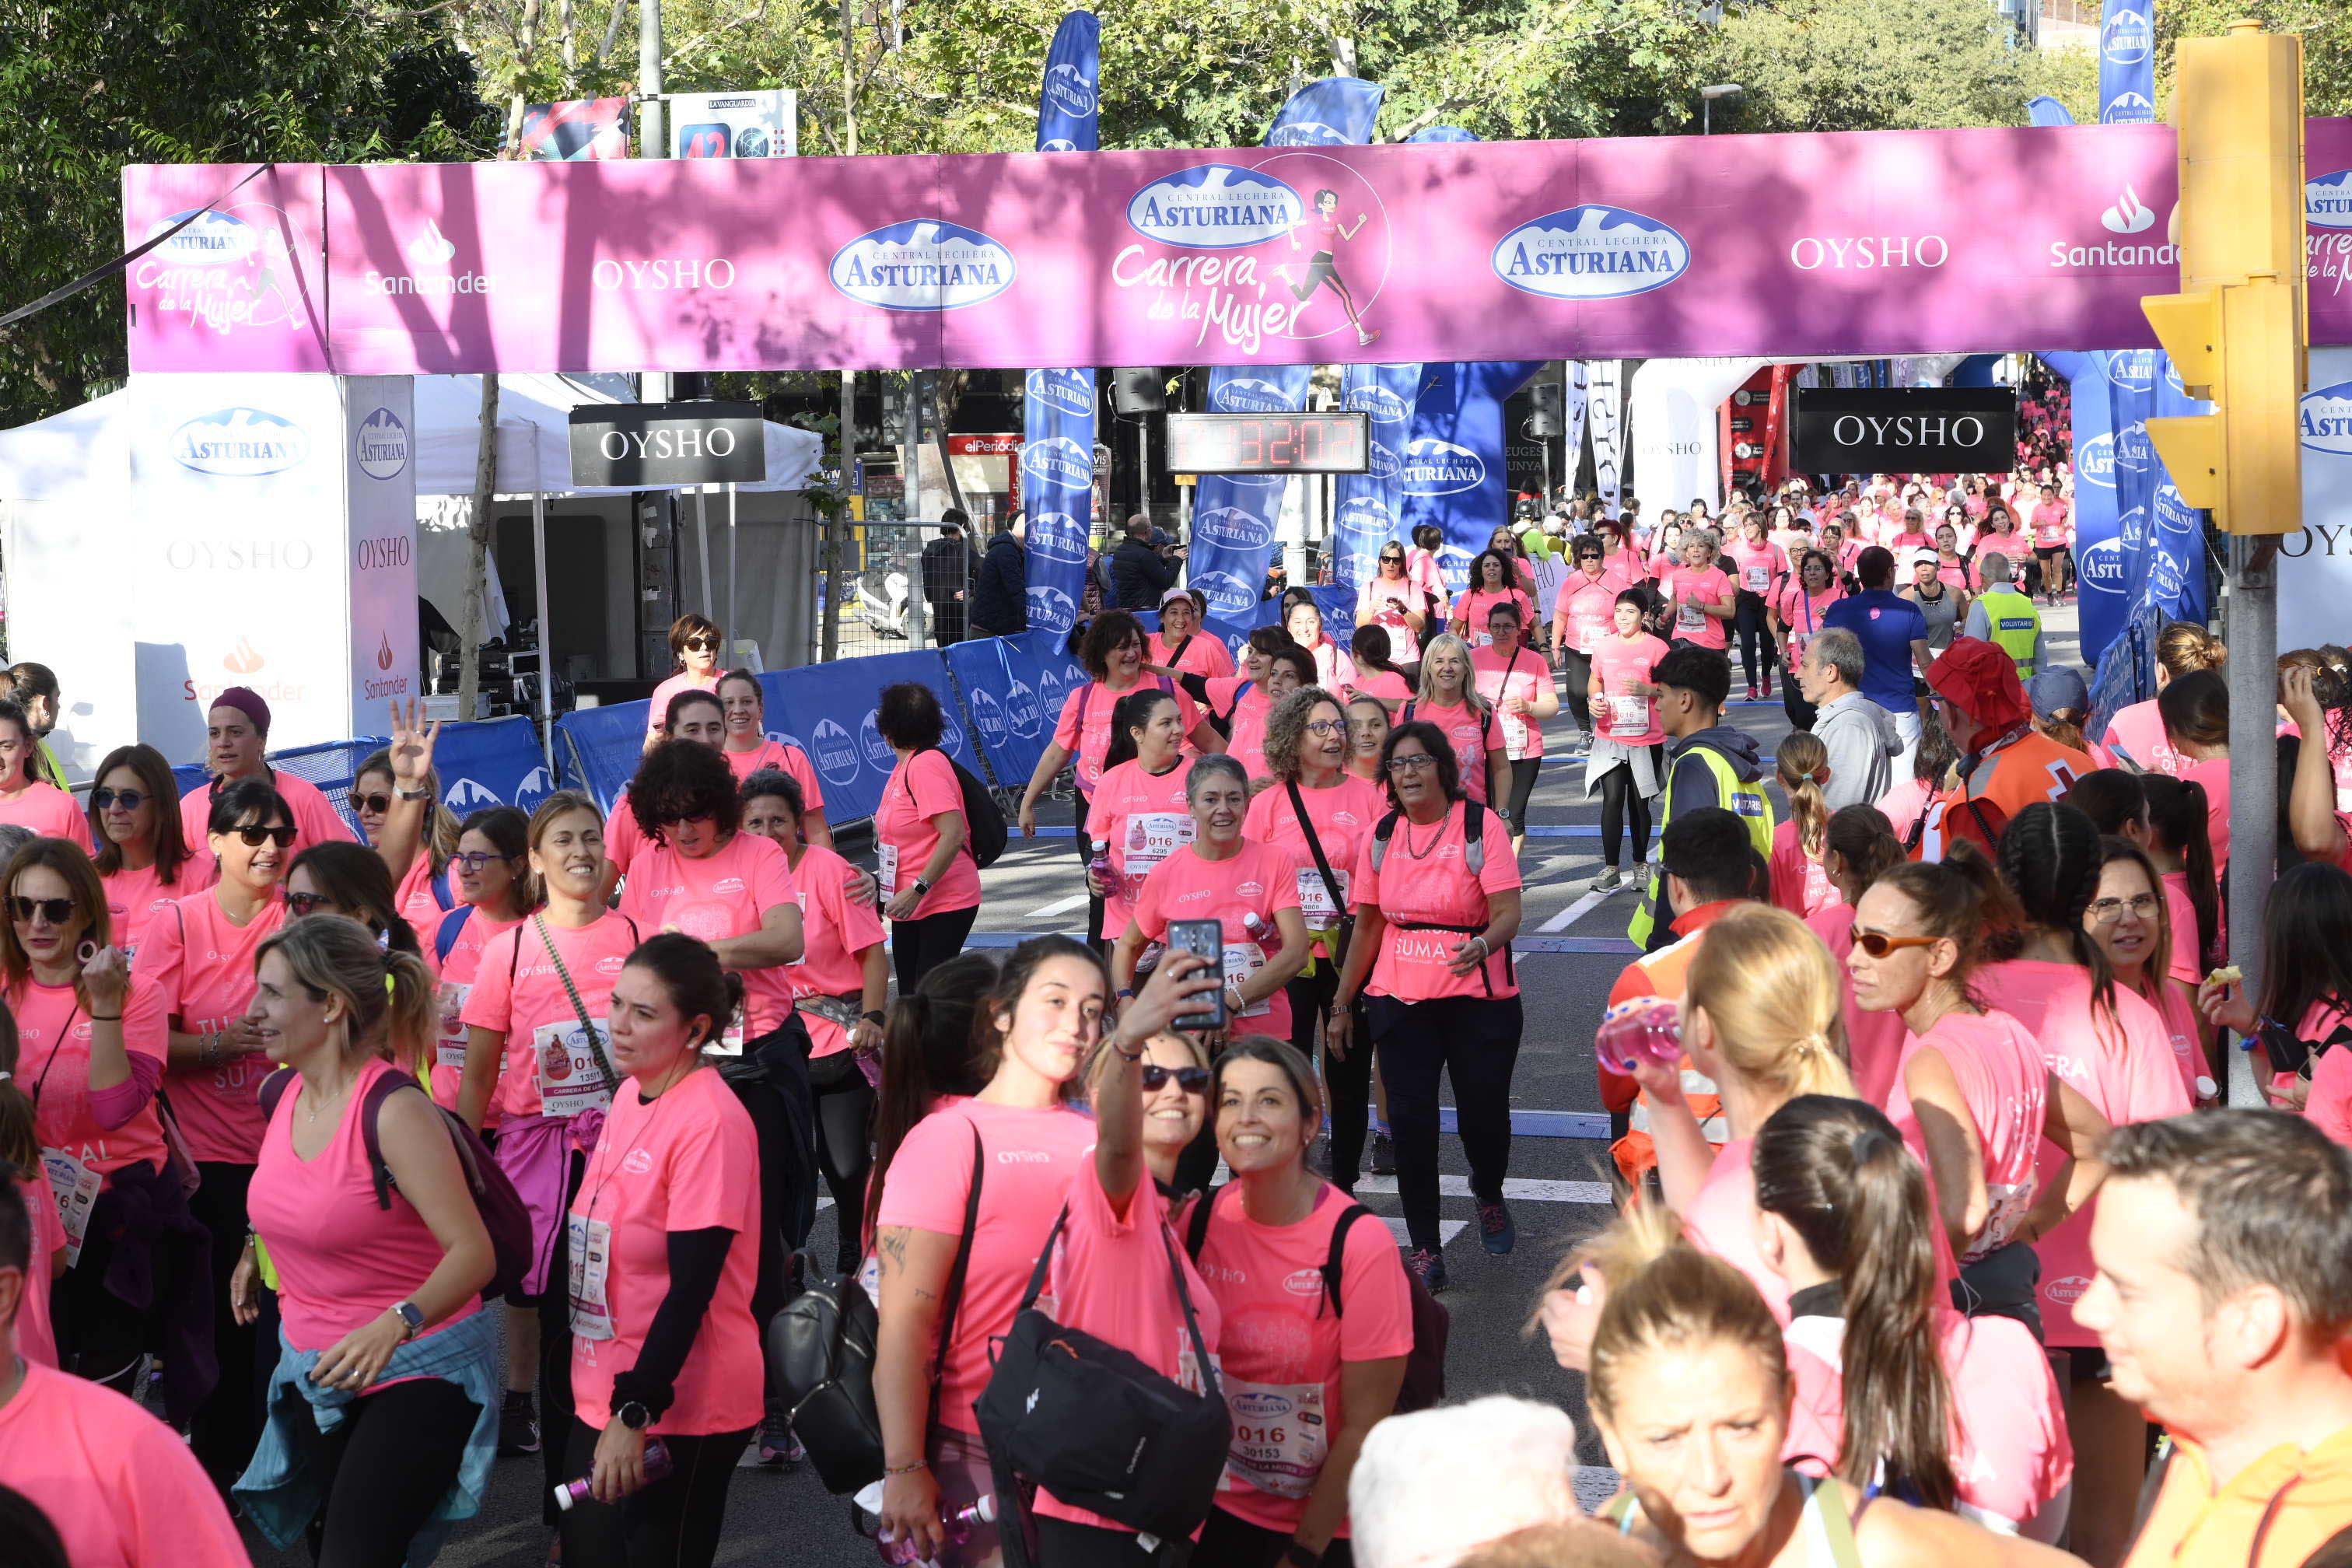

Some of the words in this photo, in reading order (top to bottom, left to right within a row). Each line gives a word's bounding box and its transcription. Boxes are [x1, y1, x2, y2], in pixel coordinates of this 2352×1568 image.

[717, 100, 756, 108] VANGUARDIA
[1167, 191, 1224, 202] CENTRAL
[1229, 191, 1286, 201] LECHERA
[1141, 195, 1291, 228] ASTURIANA
[873, 250, 931, 261] CENTRAL
[937, 248, 996, 260] LECHERA
[1537, 238, 1598, 248] CENTRAL
[1605, 236, 1668, 247] LECHERA
[1790, 235, 1949, 271] OYSHO
[2050, 240, 2180, 268] Santand
[845, 254, 1002, 288] ASTURIANA
[1111, 243, 1258, 289] Carrera
[1507, 241, 1676, 276] ASTURIANA
[365, 270, 500, 295] Santander
[592, 257, 736, 291] OYSHO
[1147, 294, 1174, 320] de
[1181, 296, 1201, 320] la
[1196, 282, 1312, 355] Mujer
[1033, 375, 1090, 410] ASTURIANA
[600, 426, 736, 461] OYSHO
[1833, 415, 1984, 447] OYSHO
[360, 434, 405, 462] ASTURIANA
[1029, 449, 1090, 483] ASTURIANA
[1027, 526, 1086, 558] ASTURIANA
[1200, 518, 1264, 544] ASTURIANA
[359, 535, 410, 571] OYSHO
[364, 676, 408, 702] Santander
[820, 747, 856, 771] ASTURIANA
[1149, 836, 1172, 846] 016
[1811, 874, 1827, 885] DE
[1178, 889, 1212, 903] OYSHO
[1395, 937, 1447, 959] SUMA
[1223, 972, 1245, 985] 16
[552, 1099, 584, 1109] OYSHO
[1237, 1425, 1286, 1443] 016
[1243, 1445, 1281, 1459] 30153
